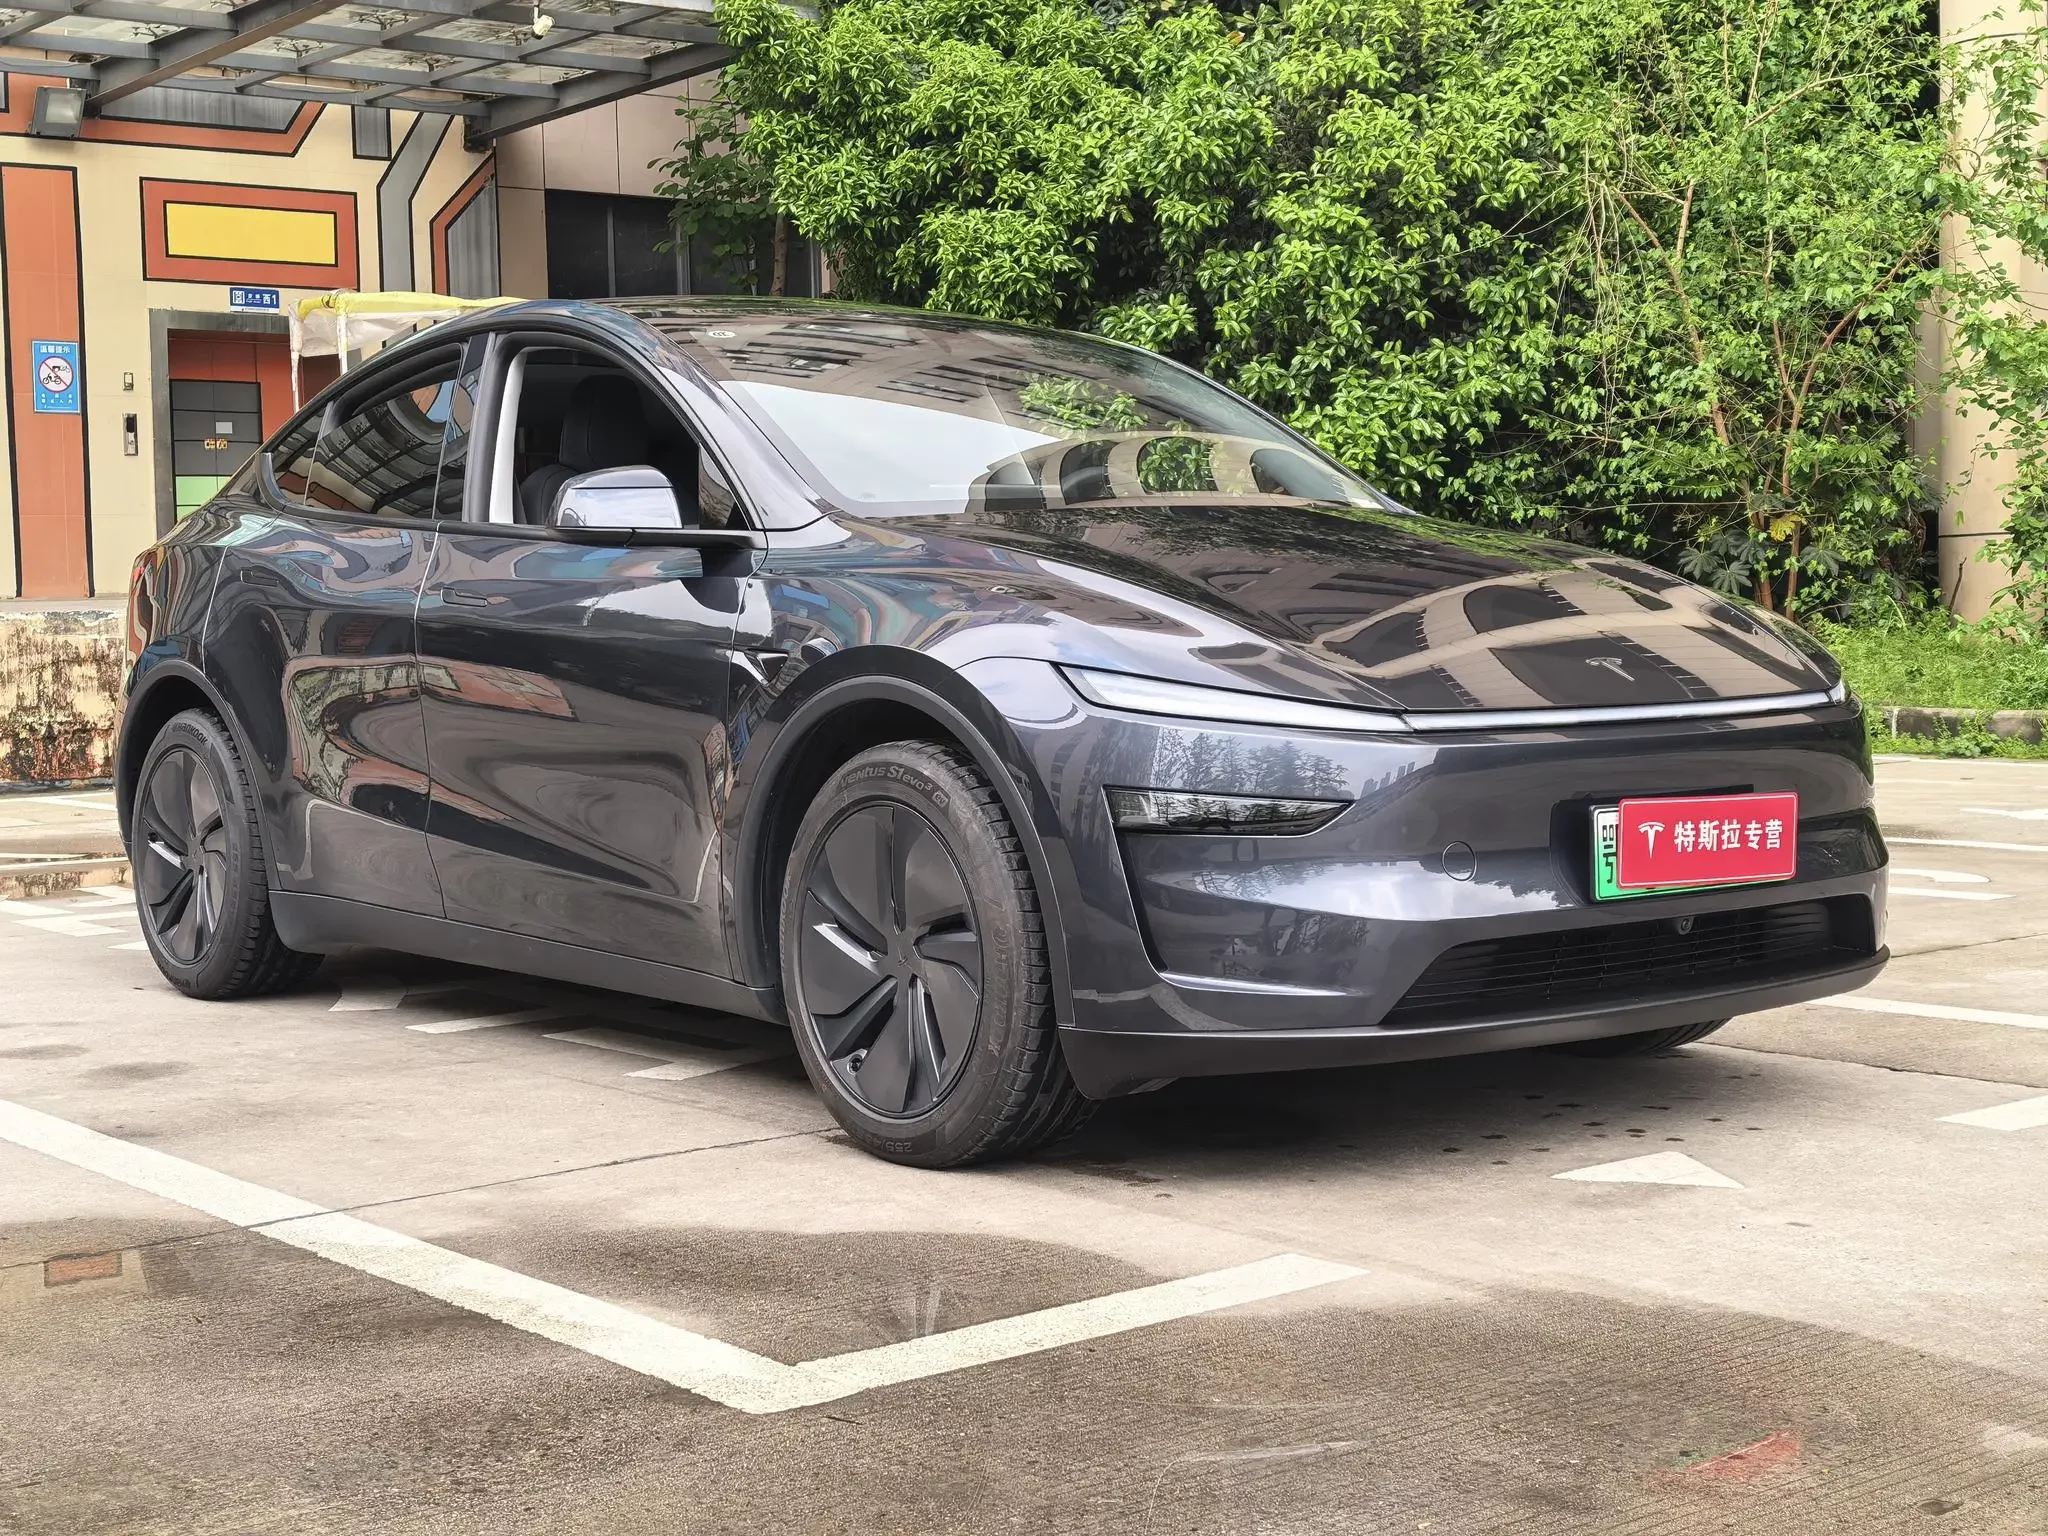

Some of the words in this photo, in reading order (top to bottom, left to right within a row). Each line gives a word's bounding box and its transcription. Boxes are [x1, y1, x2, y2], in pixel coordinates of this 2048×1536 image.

[1674, 818, 1784, 853] 特斯拉专营
